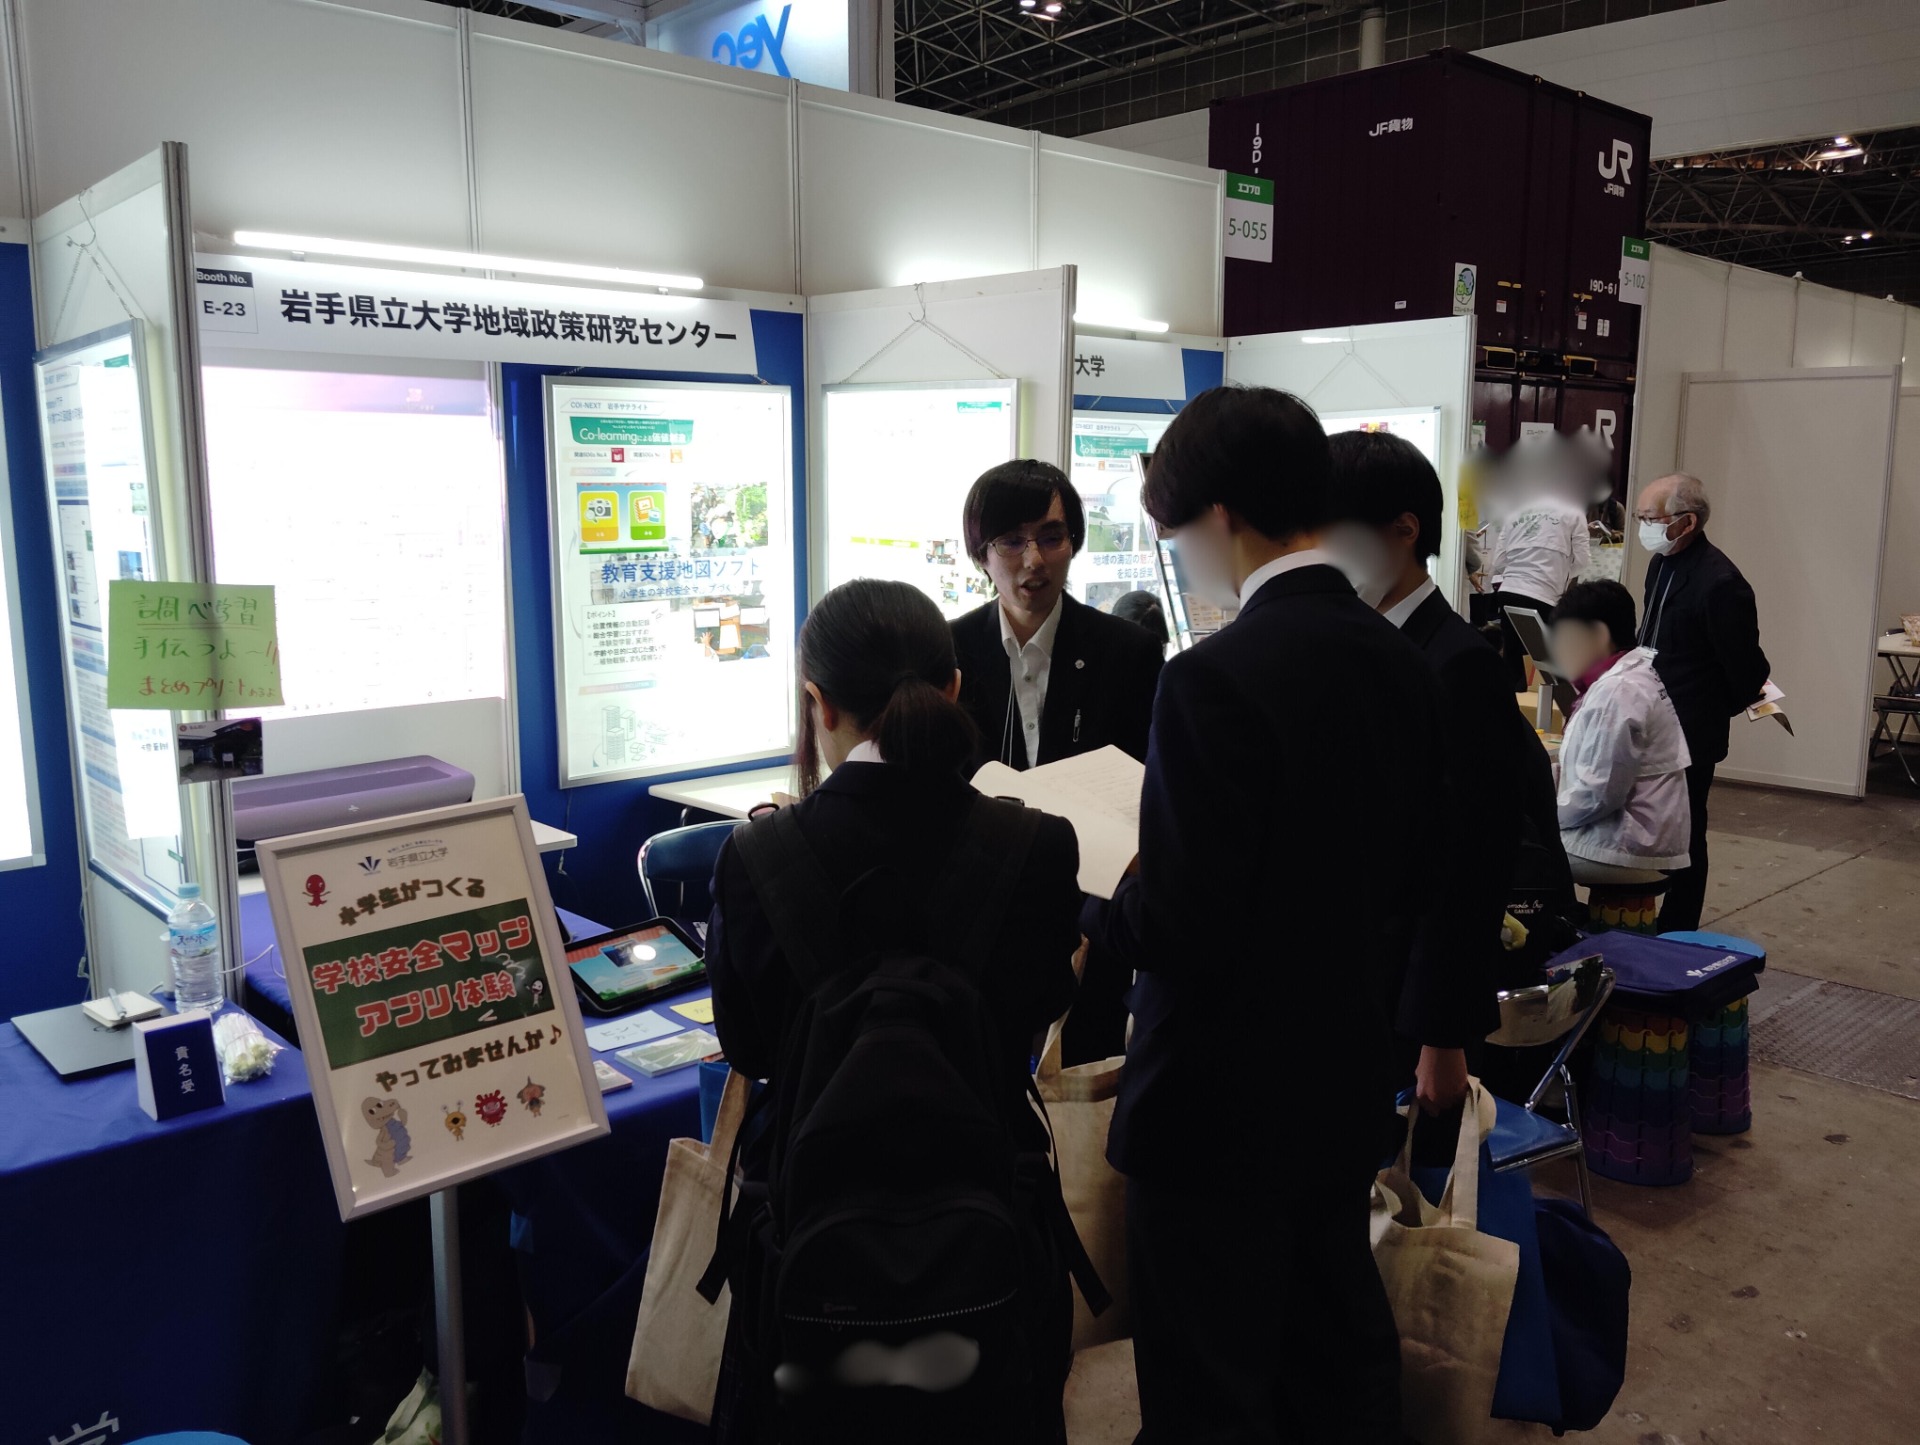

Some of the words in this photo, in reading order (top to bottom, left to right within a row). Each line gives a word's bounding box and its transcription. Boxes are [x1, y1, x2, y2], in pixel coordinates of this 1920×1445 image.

[1598, 138, 1633, 185] JR
[1228, 217, 1267, 241] 5-055
[197, 271, 227, 282] Booth
[229, 274, 247, 284] No.
[1624, 272, 1645, 289] 5-102
[204, 301, 246, 316] E-23
[280, 288, 737, 348] 岩手県立大学地域政策研究センター
[1074, 354, 1105, 376] 大学
[601, 558, 759, 583] 教育支援地図ソフト
[133, 594, 257, 625] 調べ学習
[387, 847, 448, 867] 岩手県立大学
[312, 915, 532, 995] 学校安全マップ
[355, 971, 517, 1037] アプリ体験
